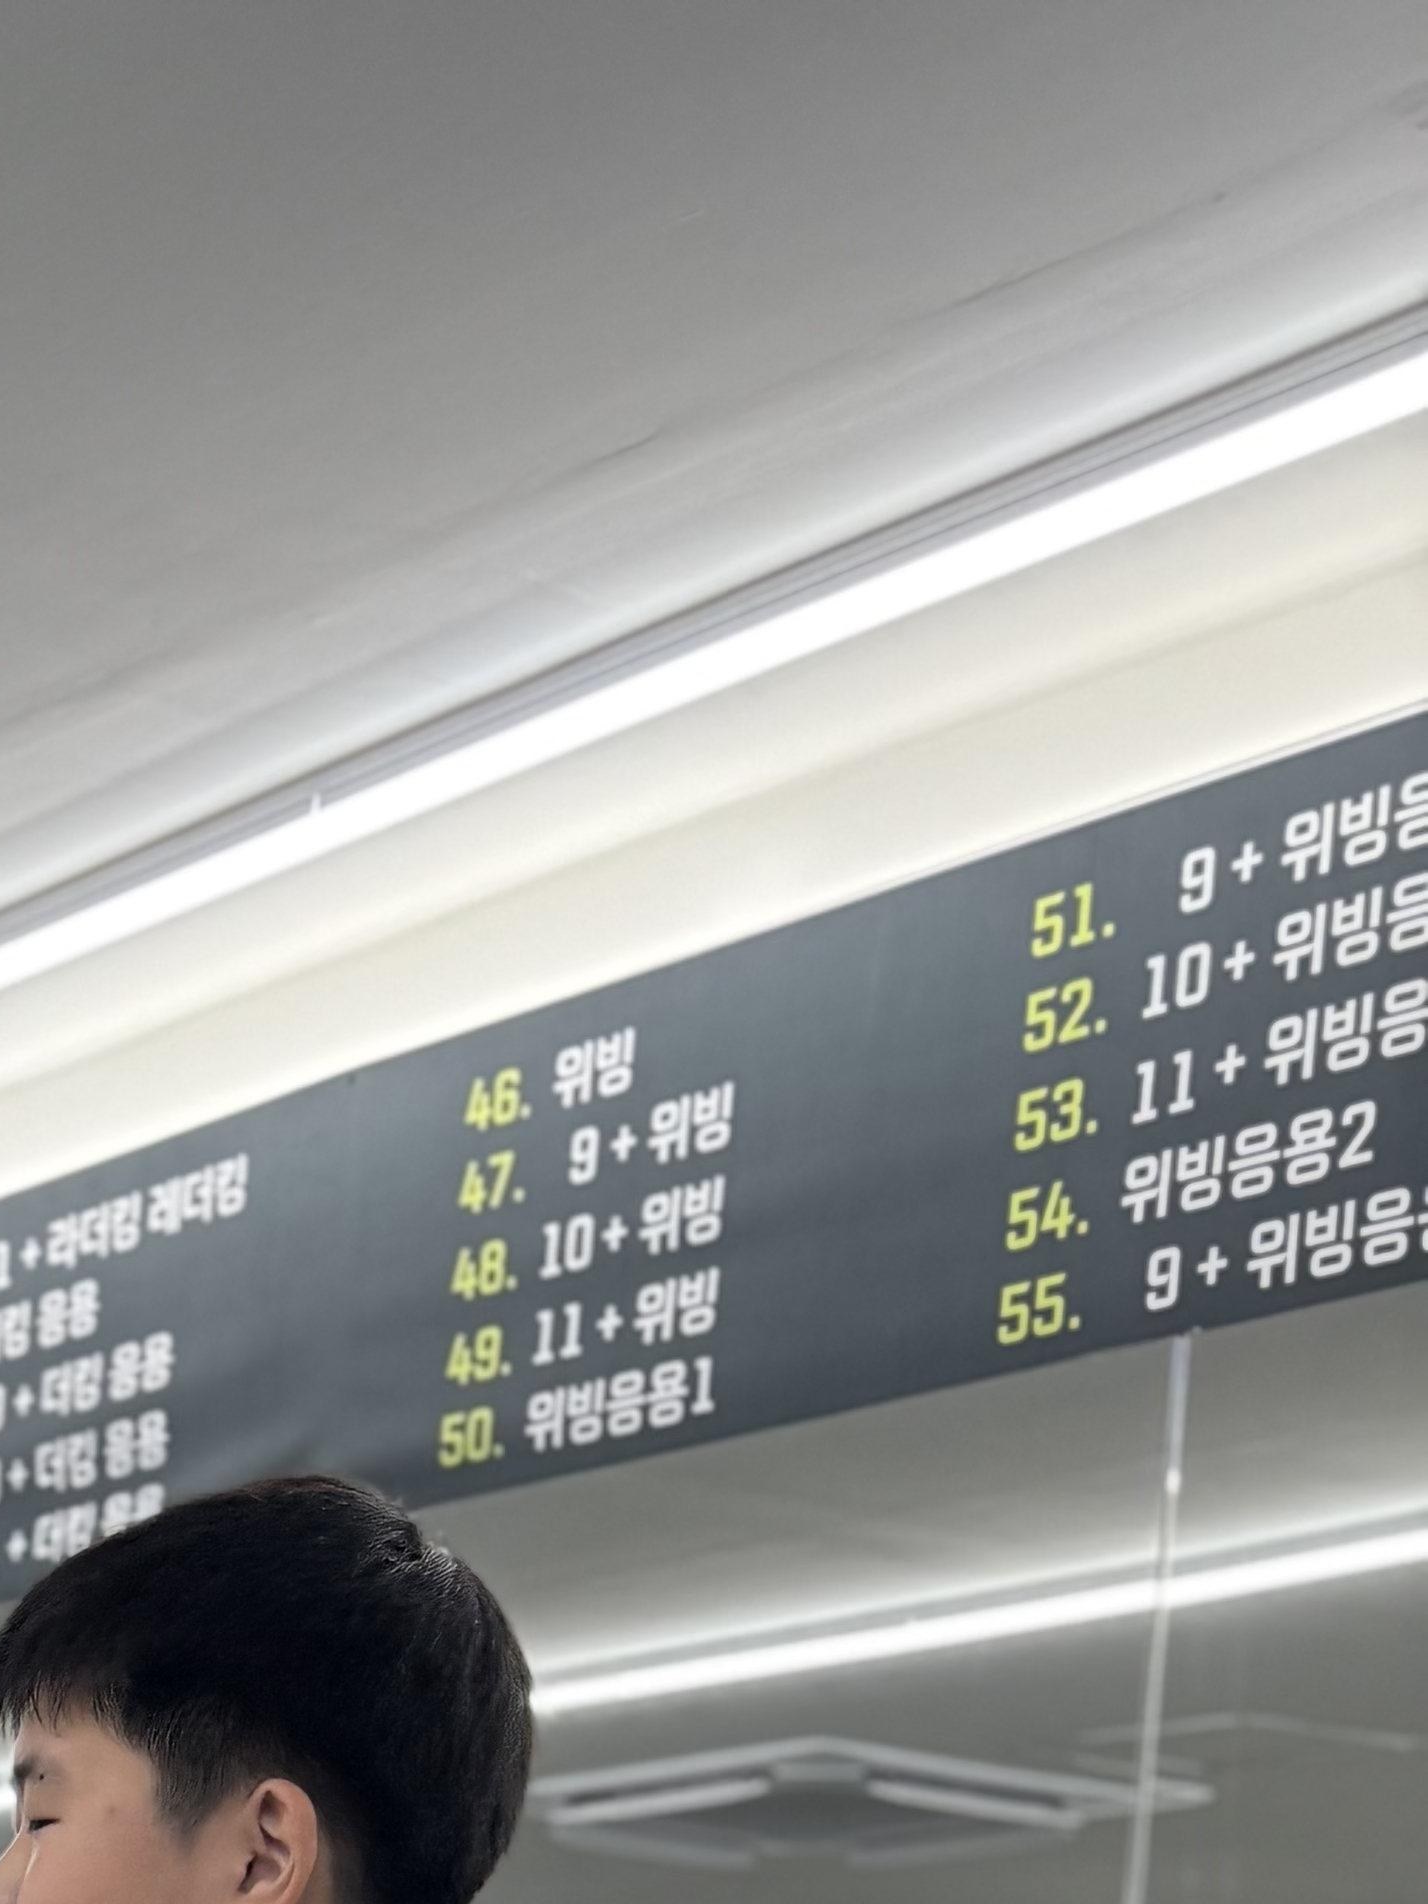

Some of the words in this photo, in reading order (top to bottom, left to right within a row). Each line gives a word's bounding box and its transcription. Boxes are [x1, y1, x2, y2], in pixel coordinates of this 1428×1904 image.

[1031, 884, 1115, 957] 51.
[1179, 847, 1216, 912] 9
[1023, 978, 1107, 1052] 52.
[1142, 943, 1213, 1019] 10
[464, 1068, 530, 1133] 46.
[552, 1028, 636, 1108] 위빙
[1014, 1079, 1098, 1151] 53.
[1131, 1051, 1195, 1124] 11
[457, 1151, 524, 1214] 47.
[567, 1126, 599, 1185] 9
[648, 1082, 734, 1165] 위빙
[1005, 1182, 1089, 1250] 54.
[1120, 1100, 1378, 1223] 위빙응용2
[451, 1240, 517, 1302] 48.
[540, 1214, 596, 1279] 10
[638, 1175, 725, 1254] 위빙
[997, 1275, 1080, 1344] 55.
[1144, 1246, 1181, 1311] 9
[1247, 1187, 1428, 1289] 위빙응
[445, 1326, 511, 1387] 49.
[530, 1302, 582, 1366] 11
[633, 1266, 719, 1348] 위빙
[438, 1409, 503, 1469] 50.
[523, 1357, 716, 1453] 위빙응용1
